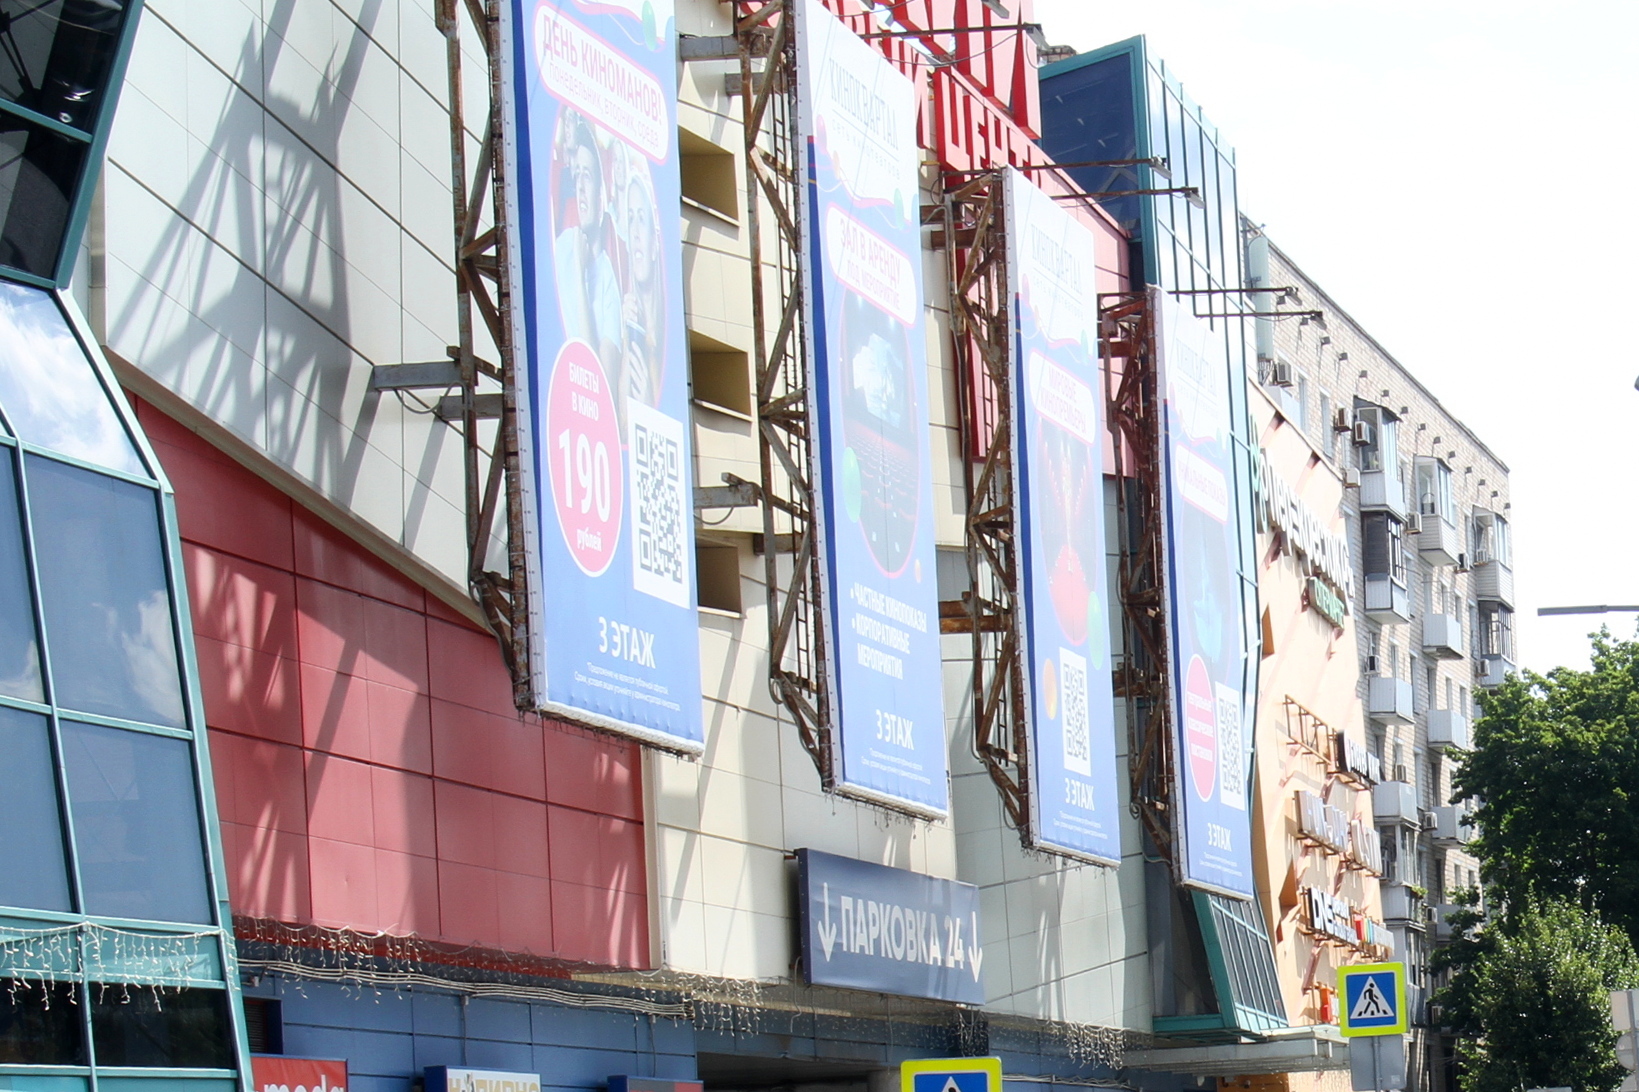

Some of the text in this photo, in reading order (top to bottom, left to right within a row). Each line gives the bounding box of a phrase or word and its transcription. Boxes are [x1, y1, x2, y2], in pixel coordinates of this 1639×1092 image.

[543, 14, 662, 125] ДЕНЬ КИНОМАНОВ!
[829, 57, 899, 151] КИНОКВАРТАЛ
[840, 218, 901, 289] ЗАЛ В АРЕНДУ
[568, 361, 600, 394] БИЛЕТЫ
[571, 394, 600, 421] В КИНО
[558, 429, 611, 524] 190
[576, 526, 602, 553] рублей
[854, 582, 928, 633] ЧАСТНЫЕ КИНОПОКАЗЫ
[598, 616, 656, 670] 3 ЭТАЖ
[856, 612, 911, 655] КОРПОРАТИВНЫЕ
[857, 642, 903, 680] МЕРОПРИЯТИЯ
[876, 709, 915, 750] 3 ЭТАЖ
[1064, 777, 1095, 811] 3 ЭТАЖ
[1207, 822, 1232, 853] 3 ЭТАЖ
[840, 895, 965, 969] ПАРКОВКА 24
